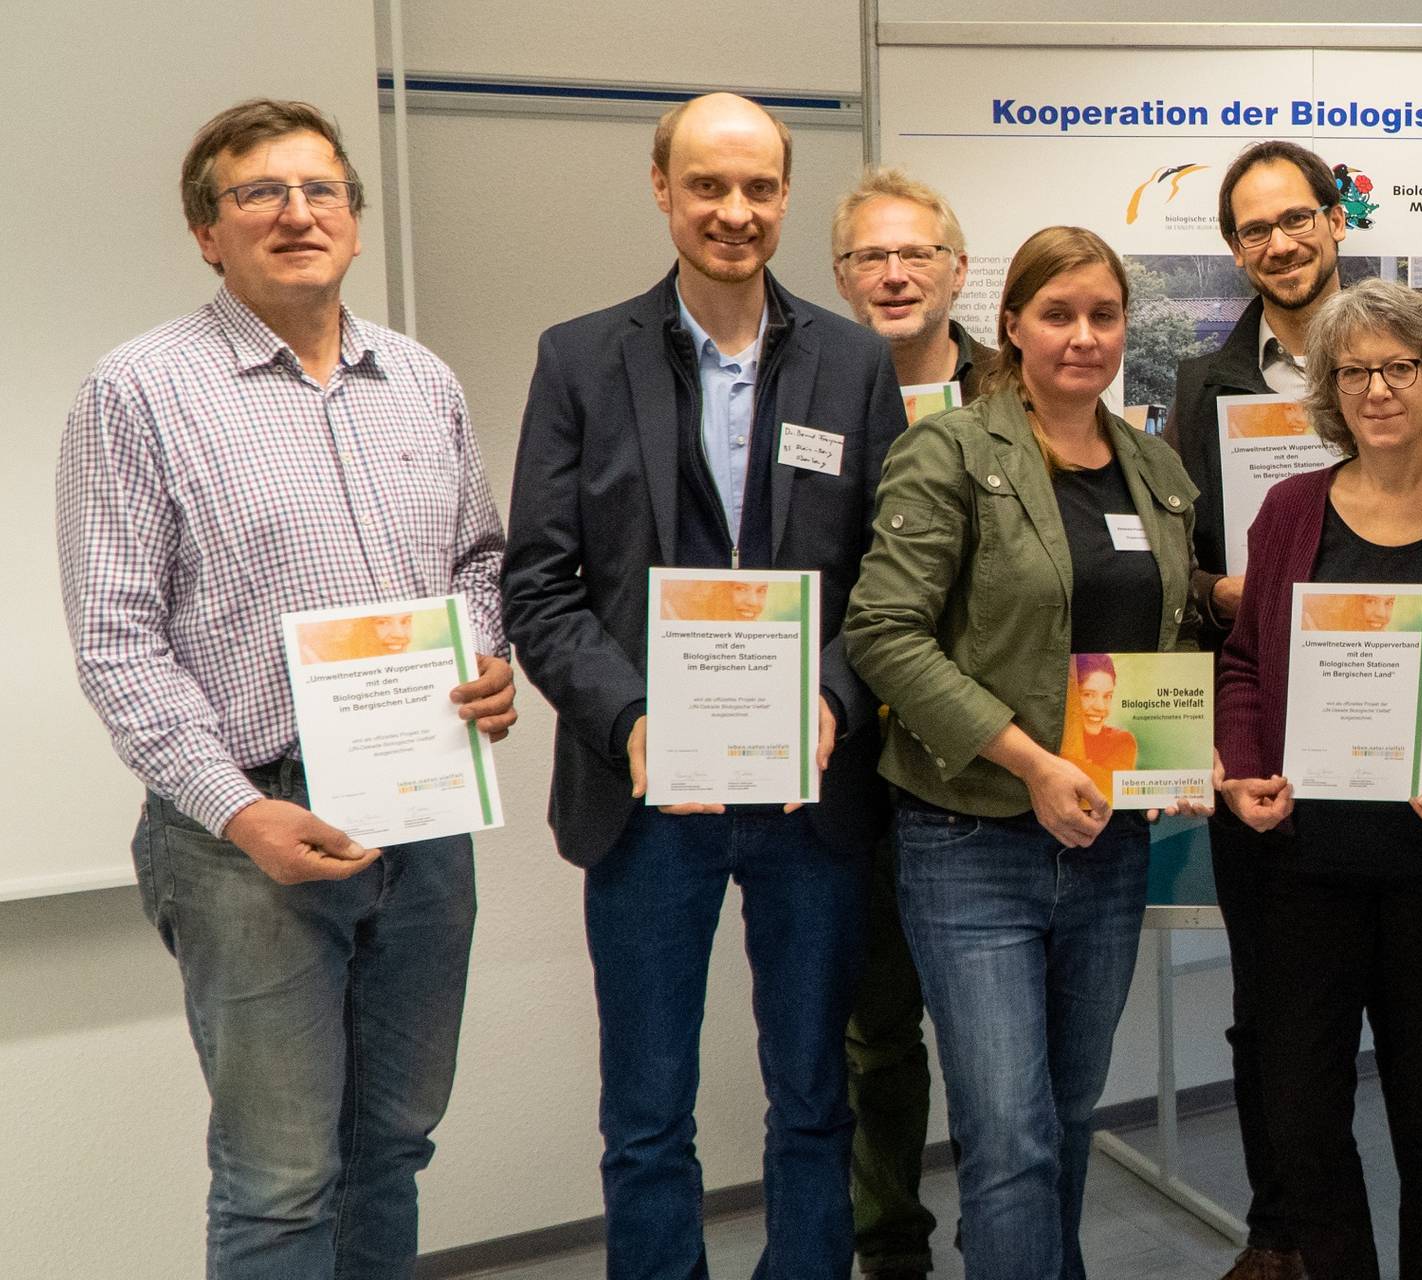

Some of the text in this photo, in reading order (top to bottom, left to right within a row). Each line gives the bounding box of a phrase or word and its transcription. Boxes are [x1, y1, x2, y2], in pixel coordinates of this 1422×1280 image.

[992, 99, 1208, 131] Kooperation
[1221, 101, 1278, 126] der
[1165, 215, 1220, 224] biologische sta
[969, 256, 1000, 264] ationen
[968, 268, 1004, 276] verband
[1249, 461, 1325, 471] Biologischen Stationen
[1263, 471, 1300, 480] Bergische
[734, 632, 799, 640] Wupperverband
[715, 642, 746, 650] mit den
[1364, 641, 1420, 649] Wupperverband
[683, 652, 777, 662] Biologischen Stationen
[384, 658, 454, 674] Wupperverband
[687, 663, 697, 671] im
[699, 663, 746, 673] Bergischen
[1319, 660, 1400, 669] Biologischen Stationen
[1333, 670, 1373, 679] Bergischen
[365, 677, 399, 688] mit den
[332, 683, 435, 703] Biologischen Stationen
[1157, 687, 1205, 697] UN-Dekade
[339, 705, 351, 713] im
[352, 699, 403, 712] Bergischen
[1121, 698, 1204, 710] Biologische Vielfalt
